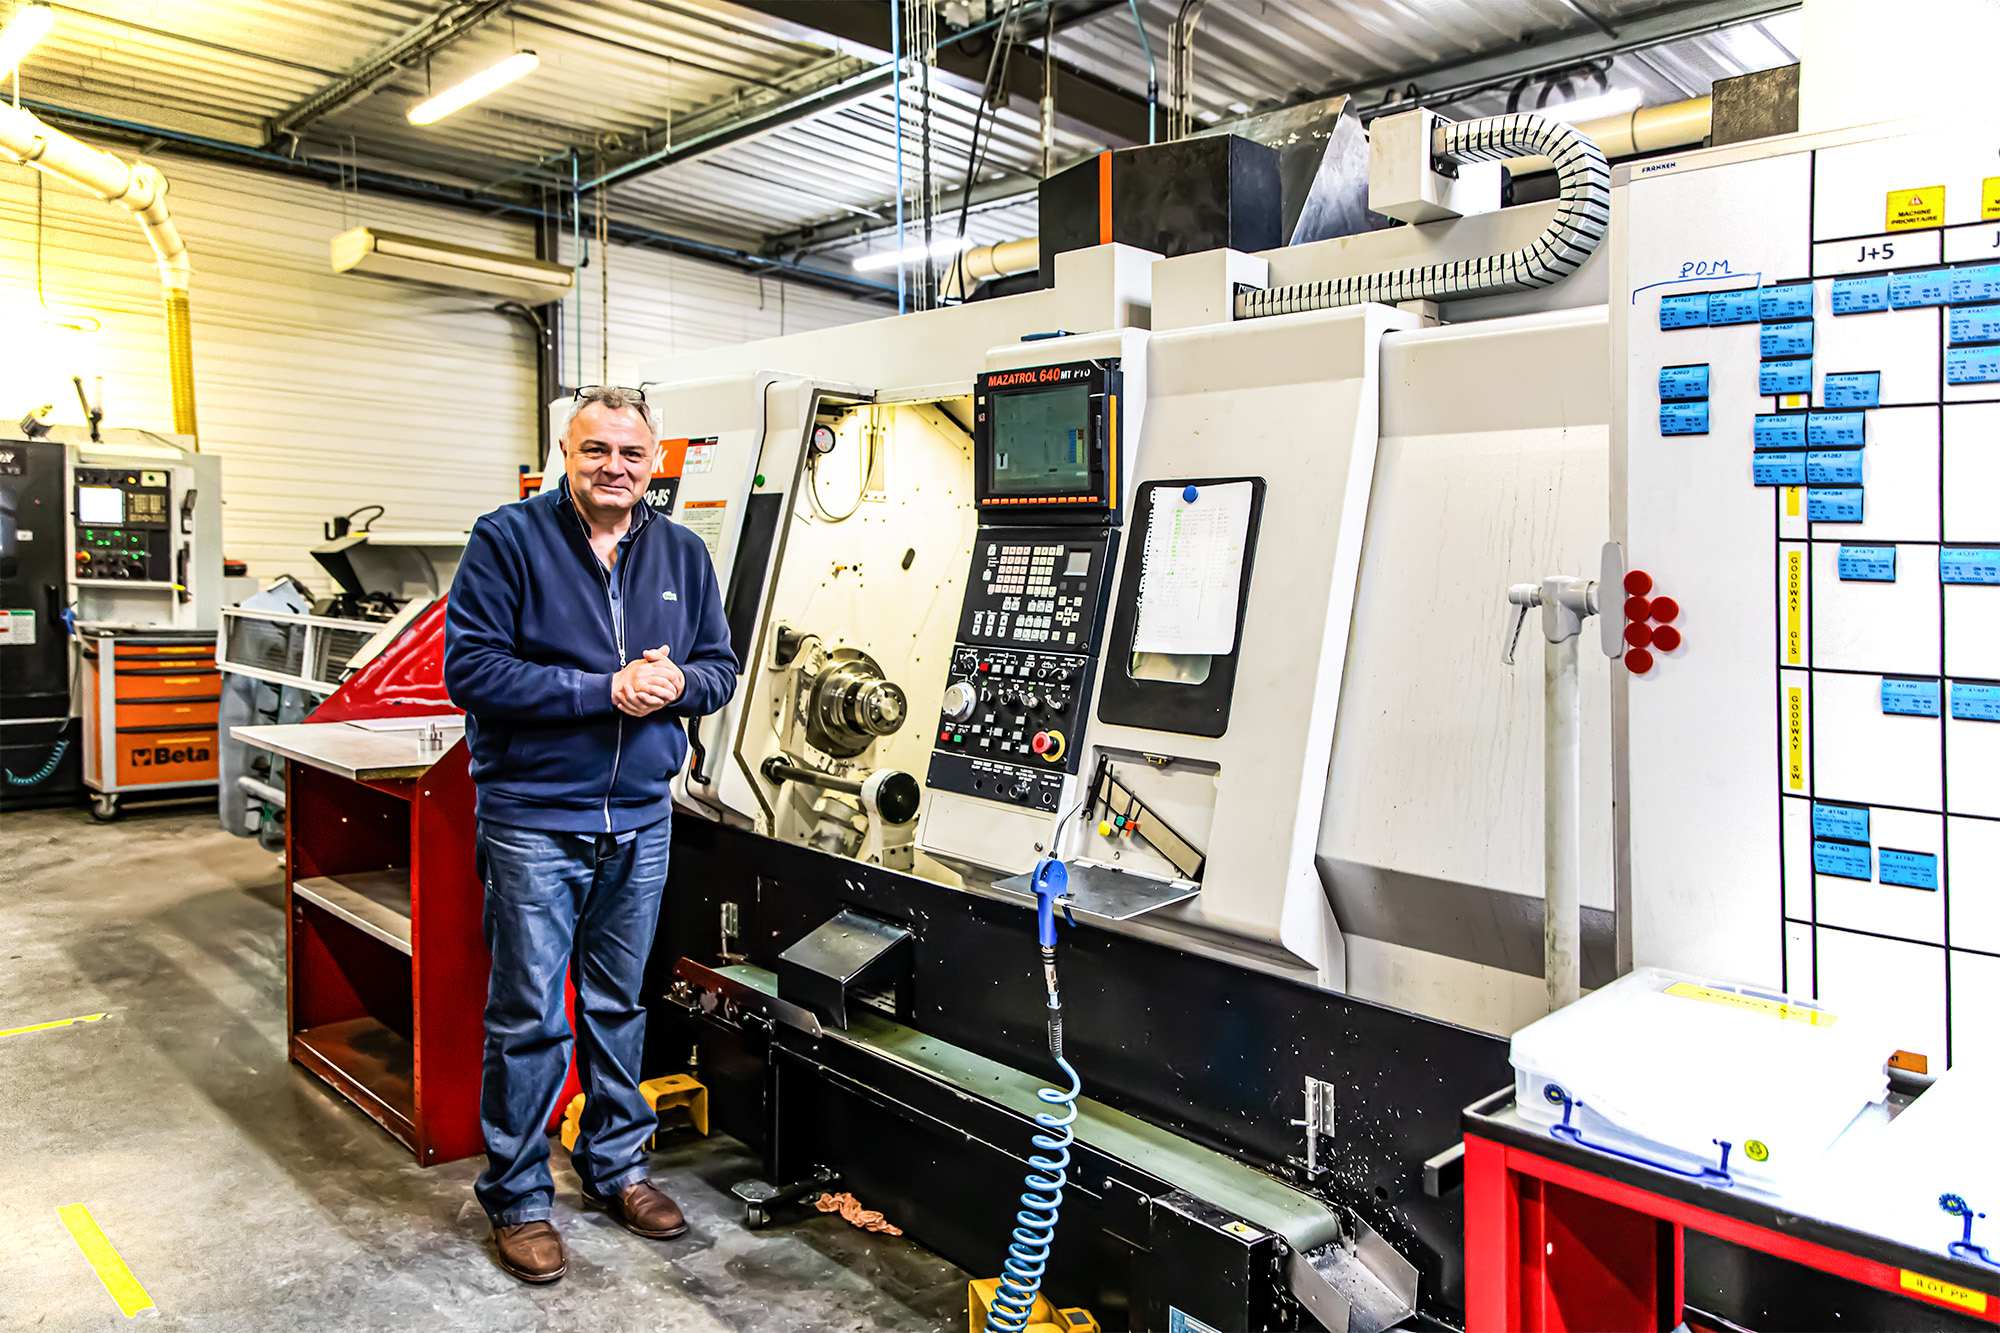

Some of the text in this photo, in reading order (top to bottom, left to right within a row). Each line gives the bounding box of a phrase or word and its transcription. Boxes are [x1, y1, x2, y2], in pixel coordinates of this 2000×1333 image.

[1641, 161, 1676, 173] FRANKEN
[1891, 215, 1938, 225] PRIORITAIRE
[1898, 208, 1931, 217] MACHINE
[1857, 242, 1894, 263] J+5
[1678, 259, 1732, 278] POM
[988, 370, 1038, 387] MAZATROL
[1039, 367, 1061, 383] 640
[1060, 370, 1071, 380] MT
[1790, 556, 1799, 655] GOODWAY GLS
[1791, 695, 1800, 780] GOODWAY SW
[154, 747, 210, 765] Beta
